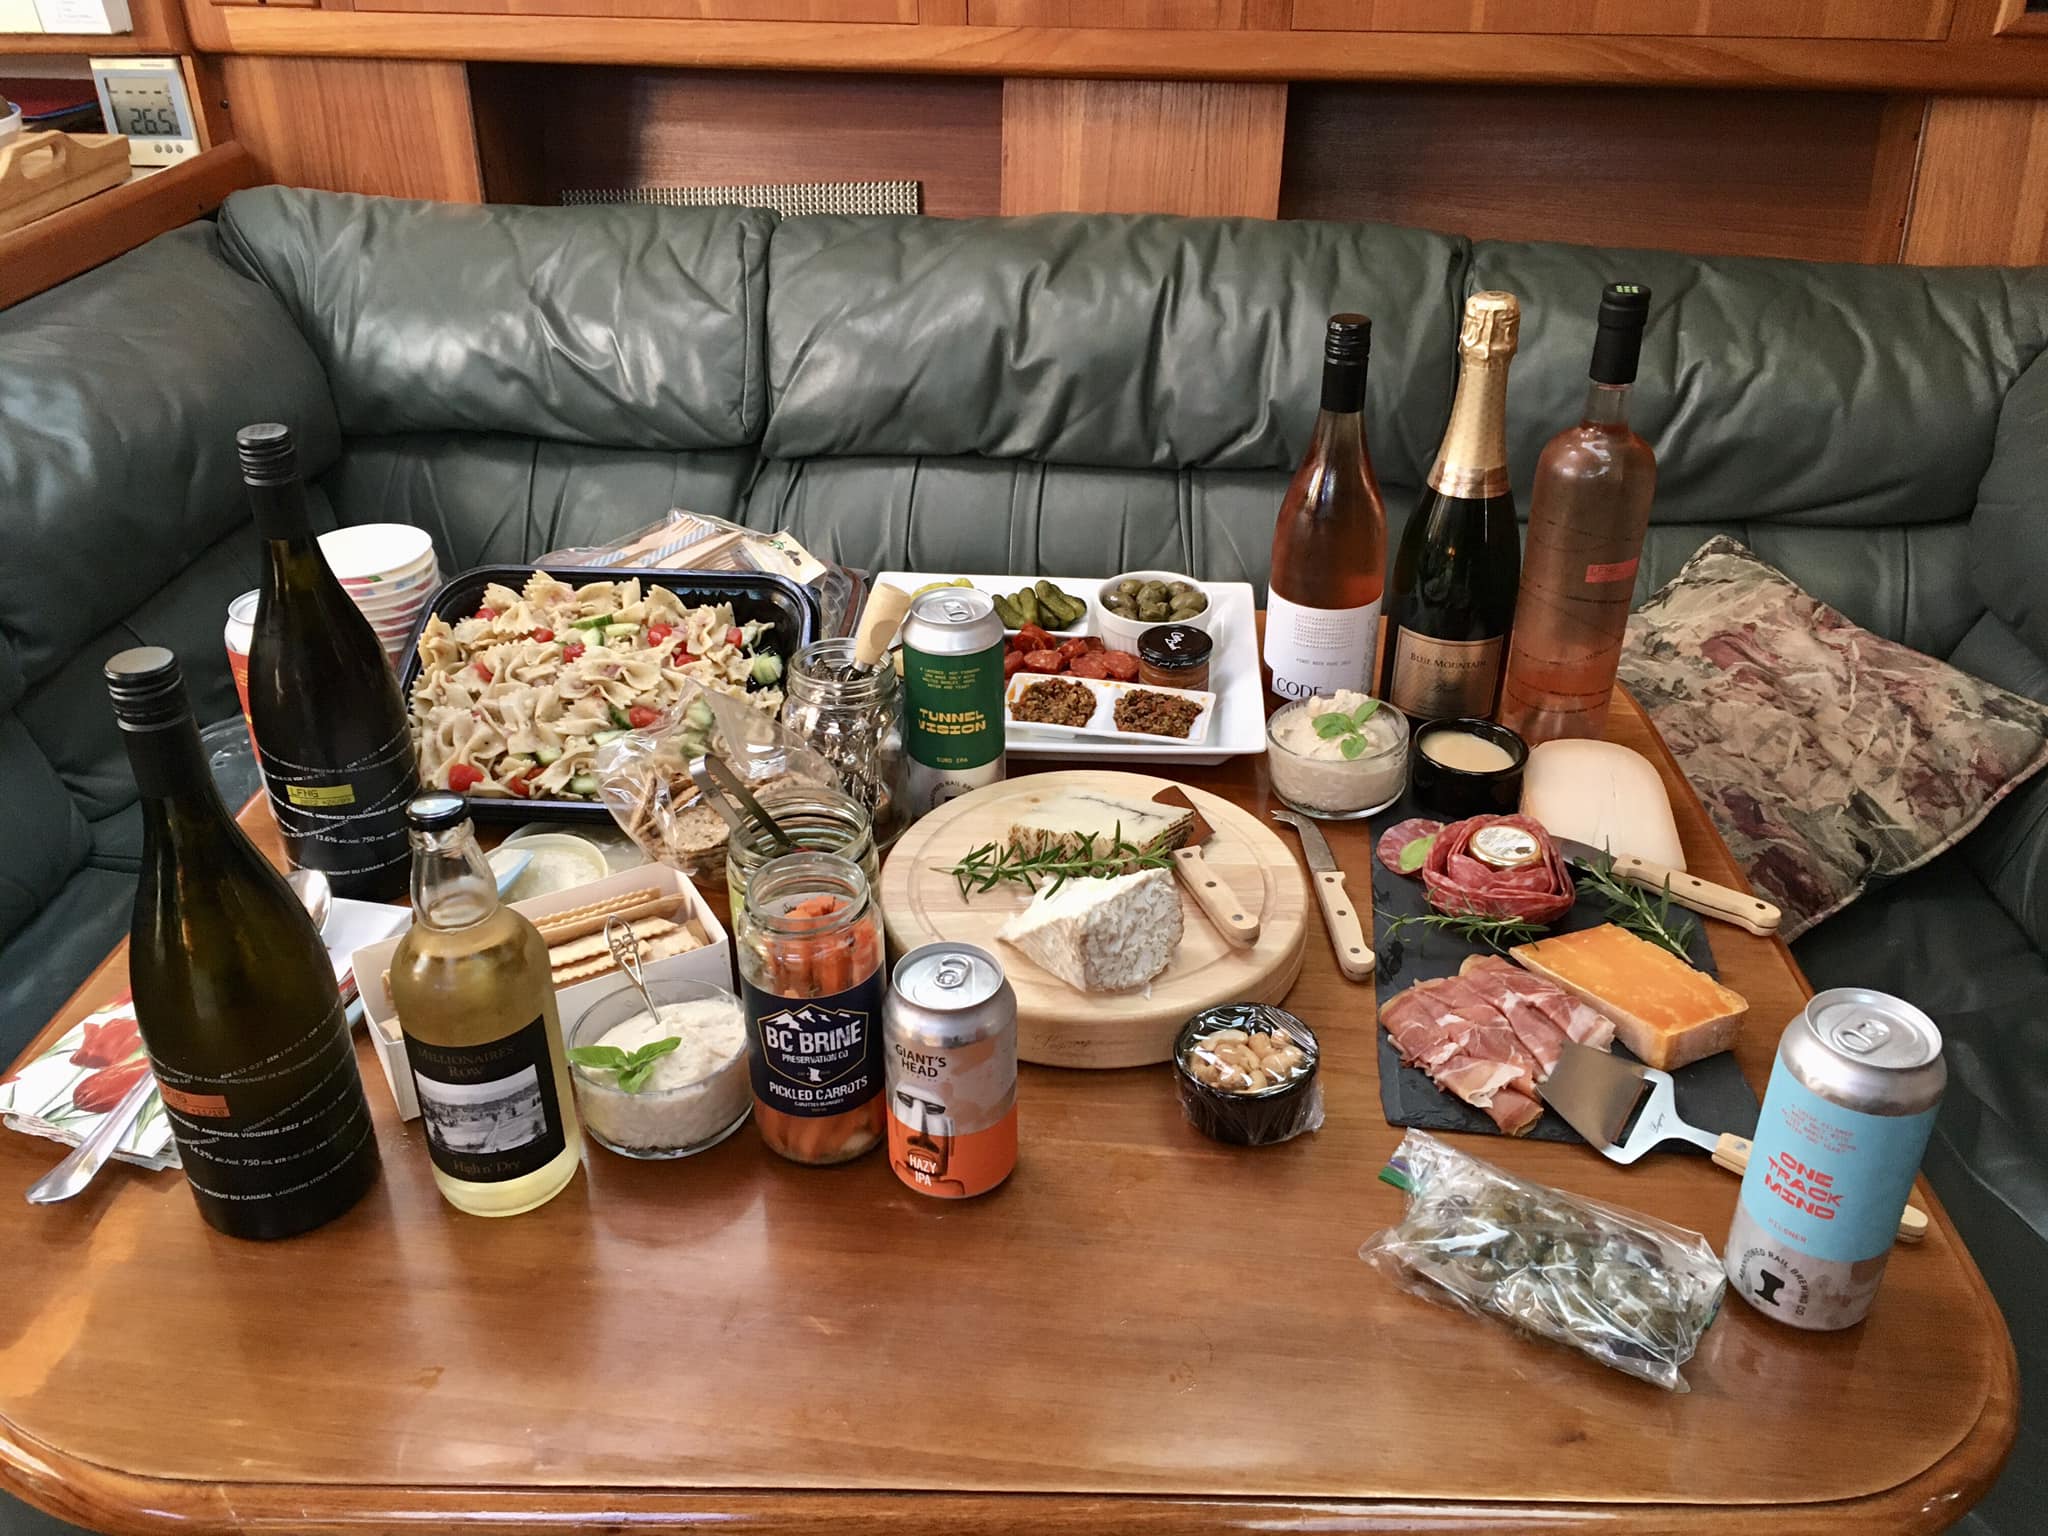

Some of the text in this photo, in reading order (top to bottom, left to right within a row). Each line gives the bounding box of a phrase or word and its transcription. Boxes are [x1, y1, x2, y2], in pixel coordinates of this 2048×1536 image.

[919, 708, 984, 723] TUNNEL
[918, 719, 986, 735] VISION
[765, 1020, 862, 1054] BC BRINE
[782, 1049, 849, 1065] PRESERVATION CO
[895, 1044, 947, 1068] GIANT'S
[901, 1060, 938, 1078] HEAD
[769, 1075, 868, 1101] PICKLED CARROTS
[201, 1128, 240, 1139] AMPHORA
[240, 1127, 280, 1139] VIOGNIER
[242, 1159, 261, 1167] 750
[909, 1153, 937, 1174] HAZY
[1780, 1151, 1835, 1188] ONE
[914, 1171, 932, 1186] IPA
[1767, 1155, 1845, 1208] TRACK
[241, 1192, 273, 1201] CANADA
[1764, 1173, 1836, 1221] MIND
[1767, 1250, 1789, 1270] RAIL
[1790, 1268, 1810, 1305] BREWING
